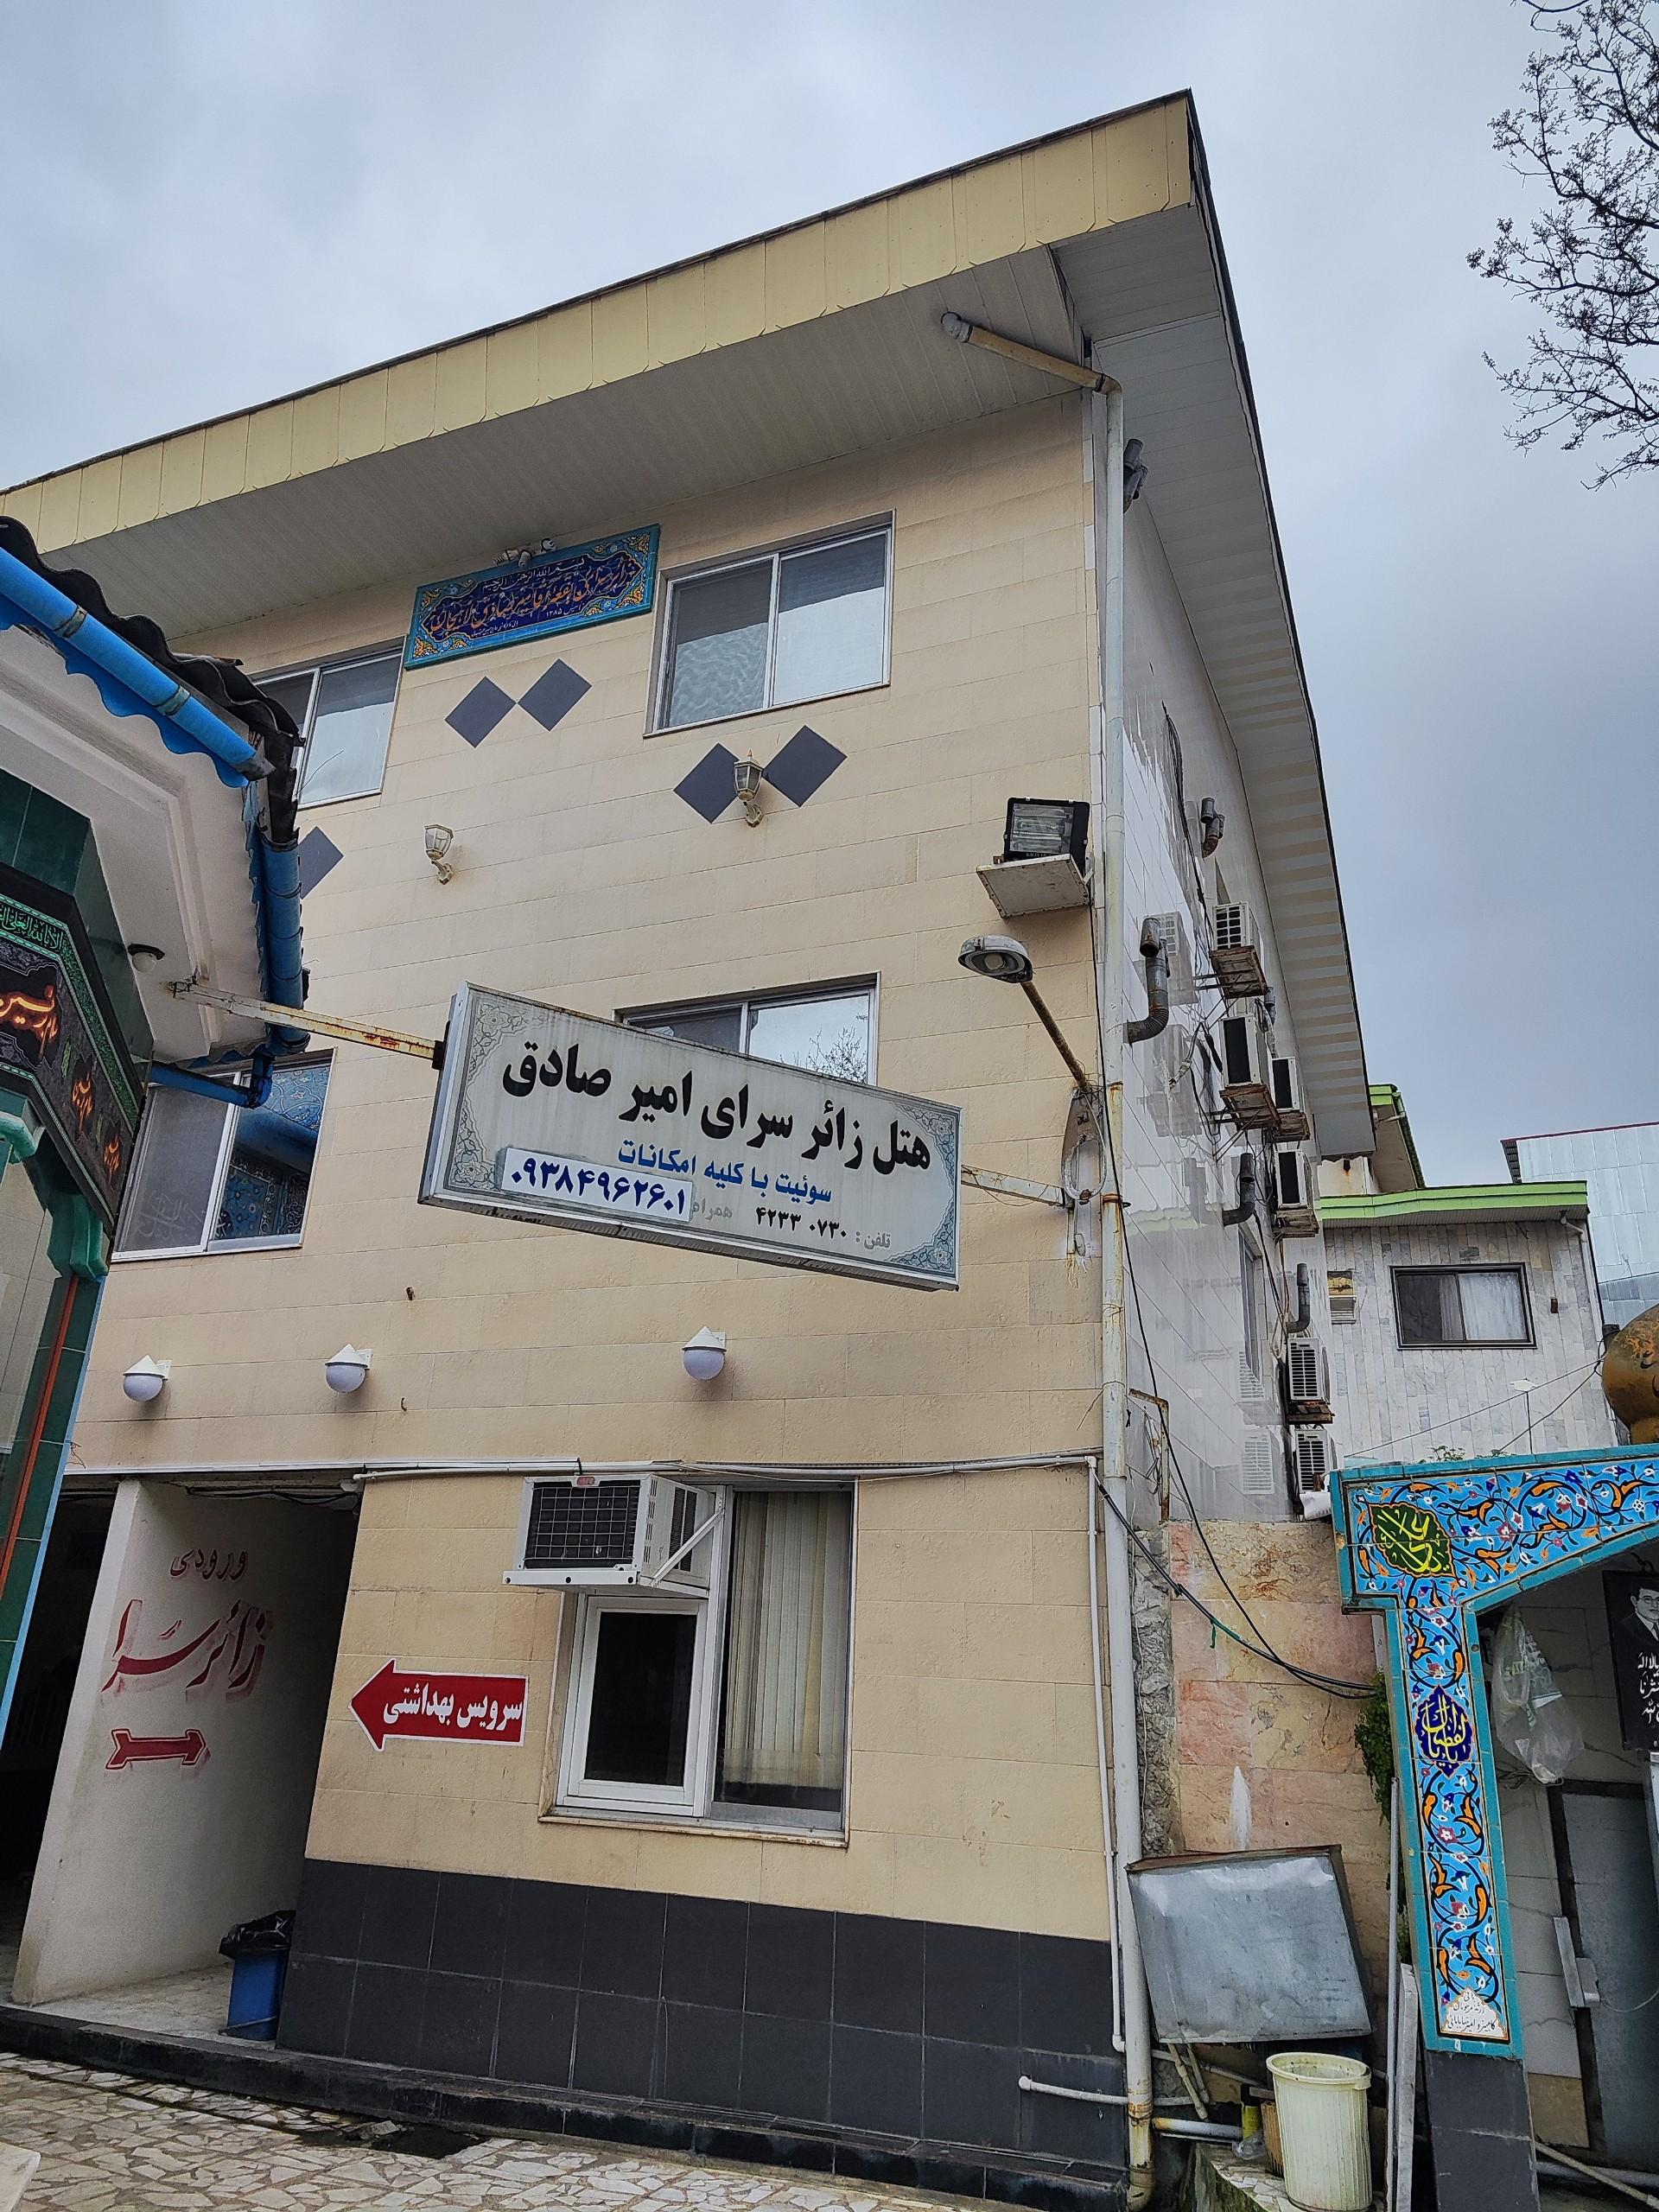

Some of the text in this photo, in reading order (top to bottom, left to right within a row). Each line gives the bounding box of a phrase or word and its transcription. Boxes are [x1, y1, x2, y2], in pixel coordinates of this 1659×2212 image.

[502, 1039, 612, 1096] صادق
[619, 1071, 693, 1122] امیر
[701, 1084, 793, 1149] سرای
[618, 1140, 832, 1205] سوئیت با کلیه امکانات
[874, 1120, 931, 1176] هتل
[511, 1158, 685, 1215] ۰۹۳۸۴۹۶۲۶۰۱
[169, 1548, 249, 1581] ورودی
[383, 1681, 524, 1732] سرویس بهداشتی
